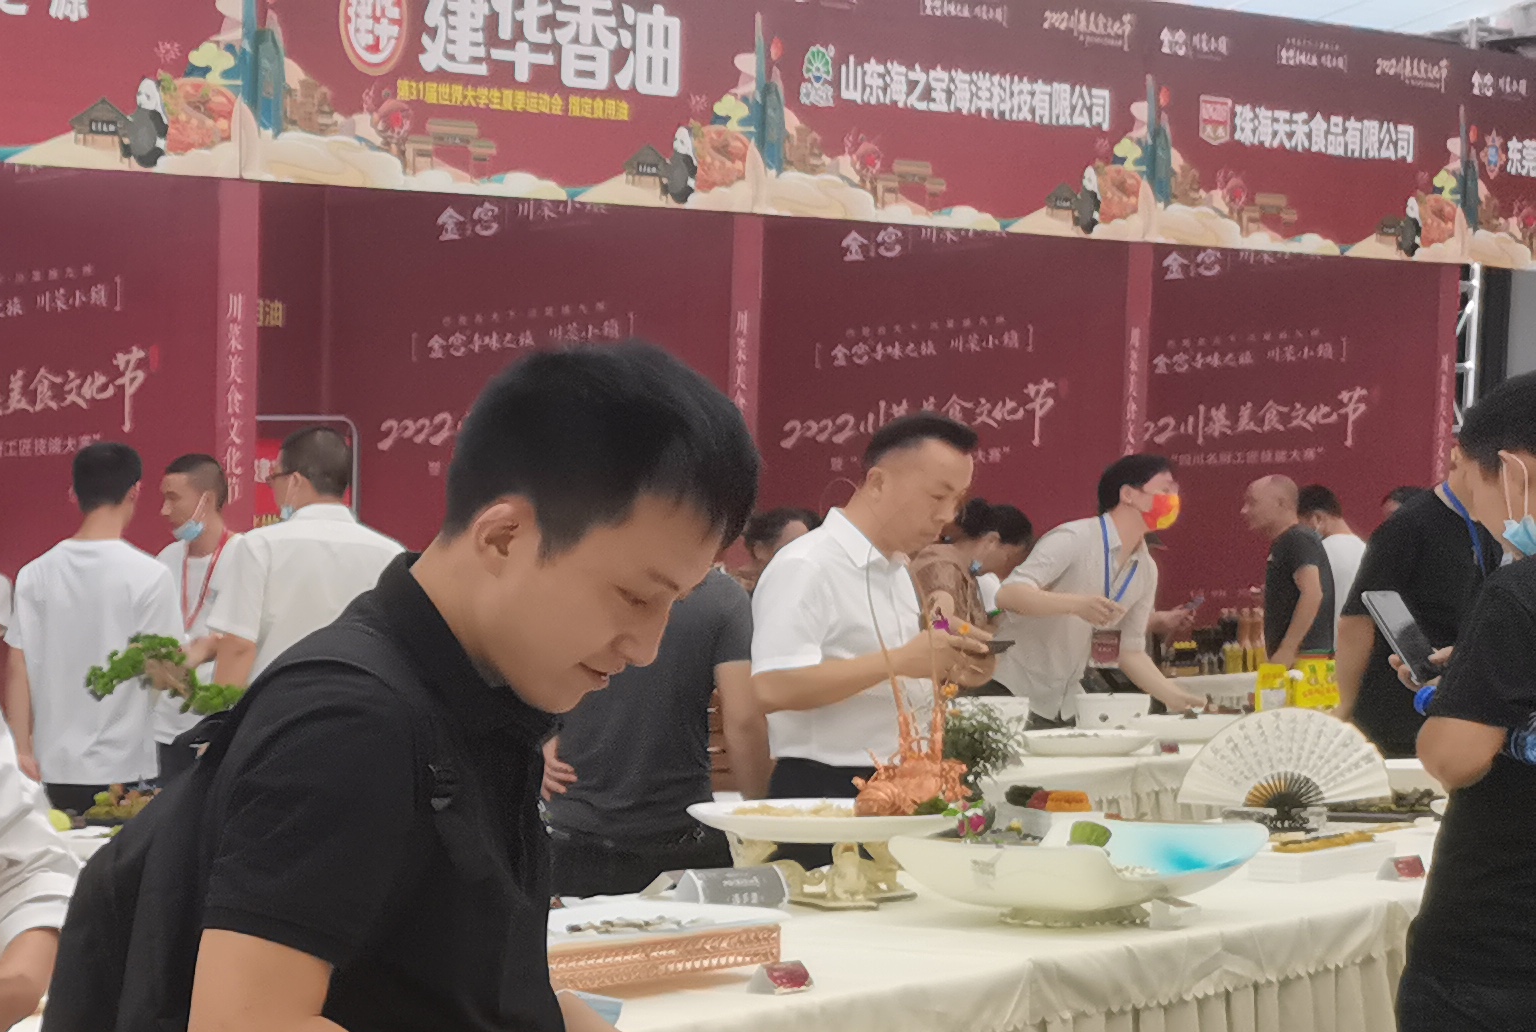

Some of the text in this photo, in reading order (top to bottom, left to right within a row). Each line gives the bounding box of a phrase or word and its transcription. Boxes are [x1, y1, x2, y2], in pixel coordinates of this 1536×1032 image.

[840, 54, 1110, 131] 山东海之宝海洋科技有限公司
[1233, 104, 1415, 163] 珠海天禾食品有限公司
